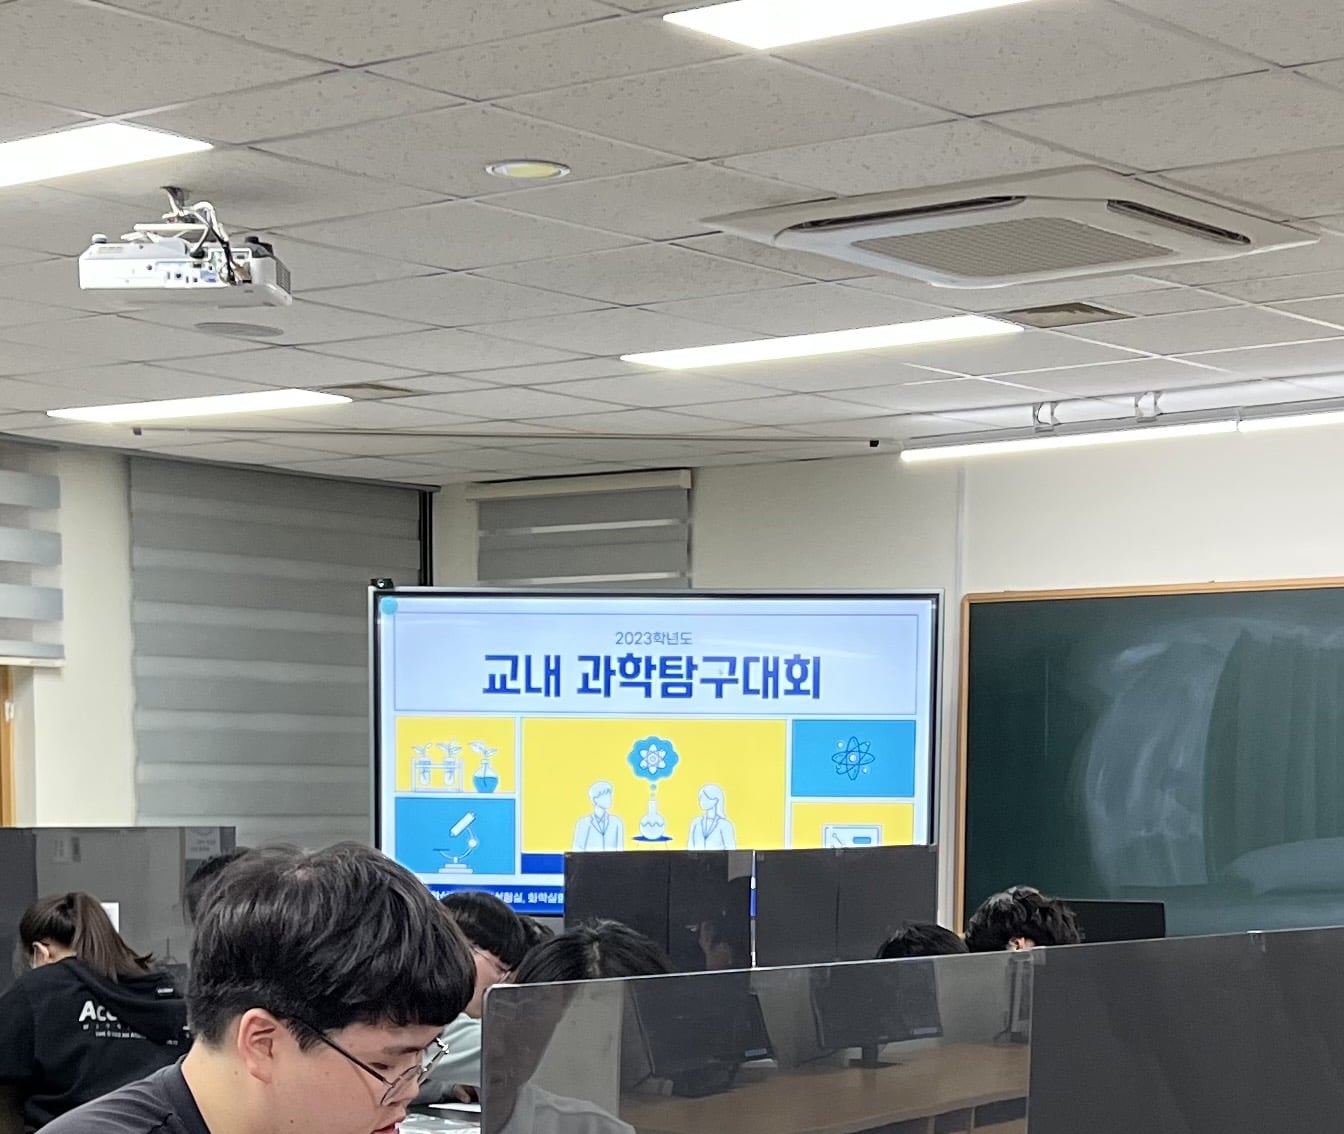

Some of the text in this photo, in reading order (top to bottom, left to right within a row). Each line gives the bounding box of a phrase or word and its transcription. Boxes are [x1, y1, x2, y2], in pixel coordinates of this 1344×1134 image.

[615, 631, 693, 645] 2023학년도
[482, 653, 822, 699] 교내 과학탐구대회
